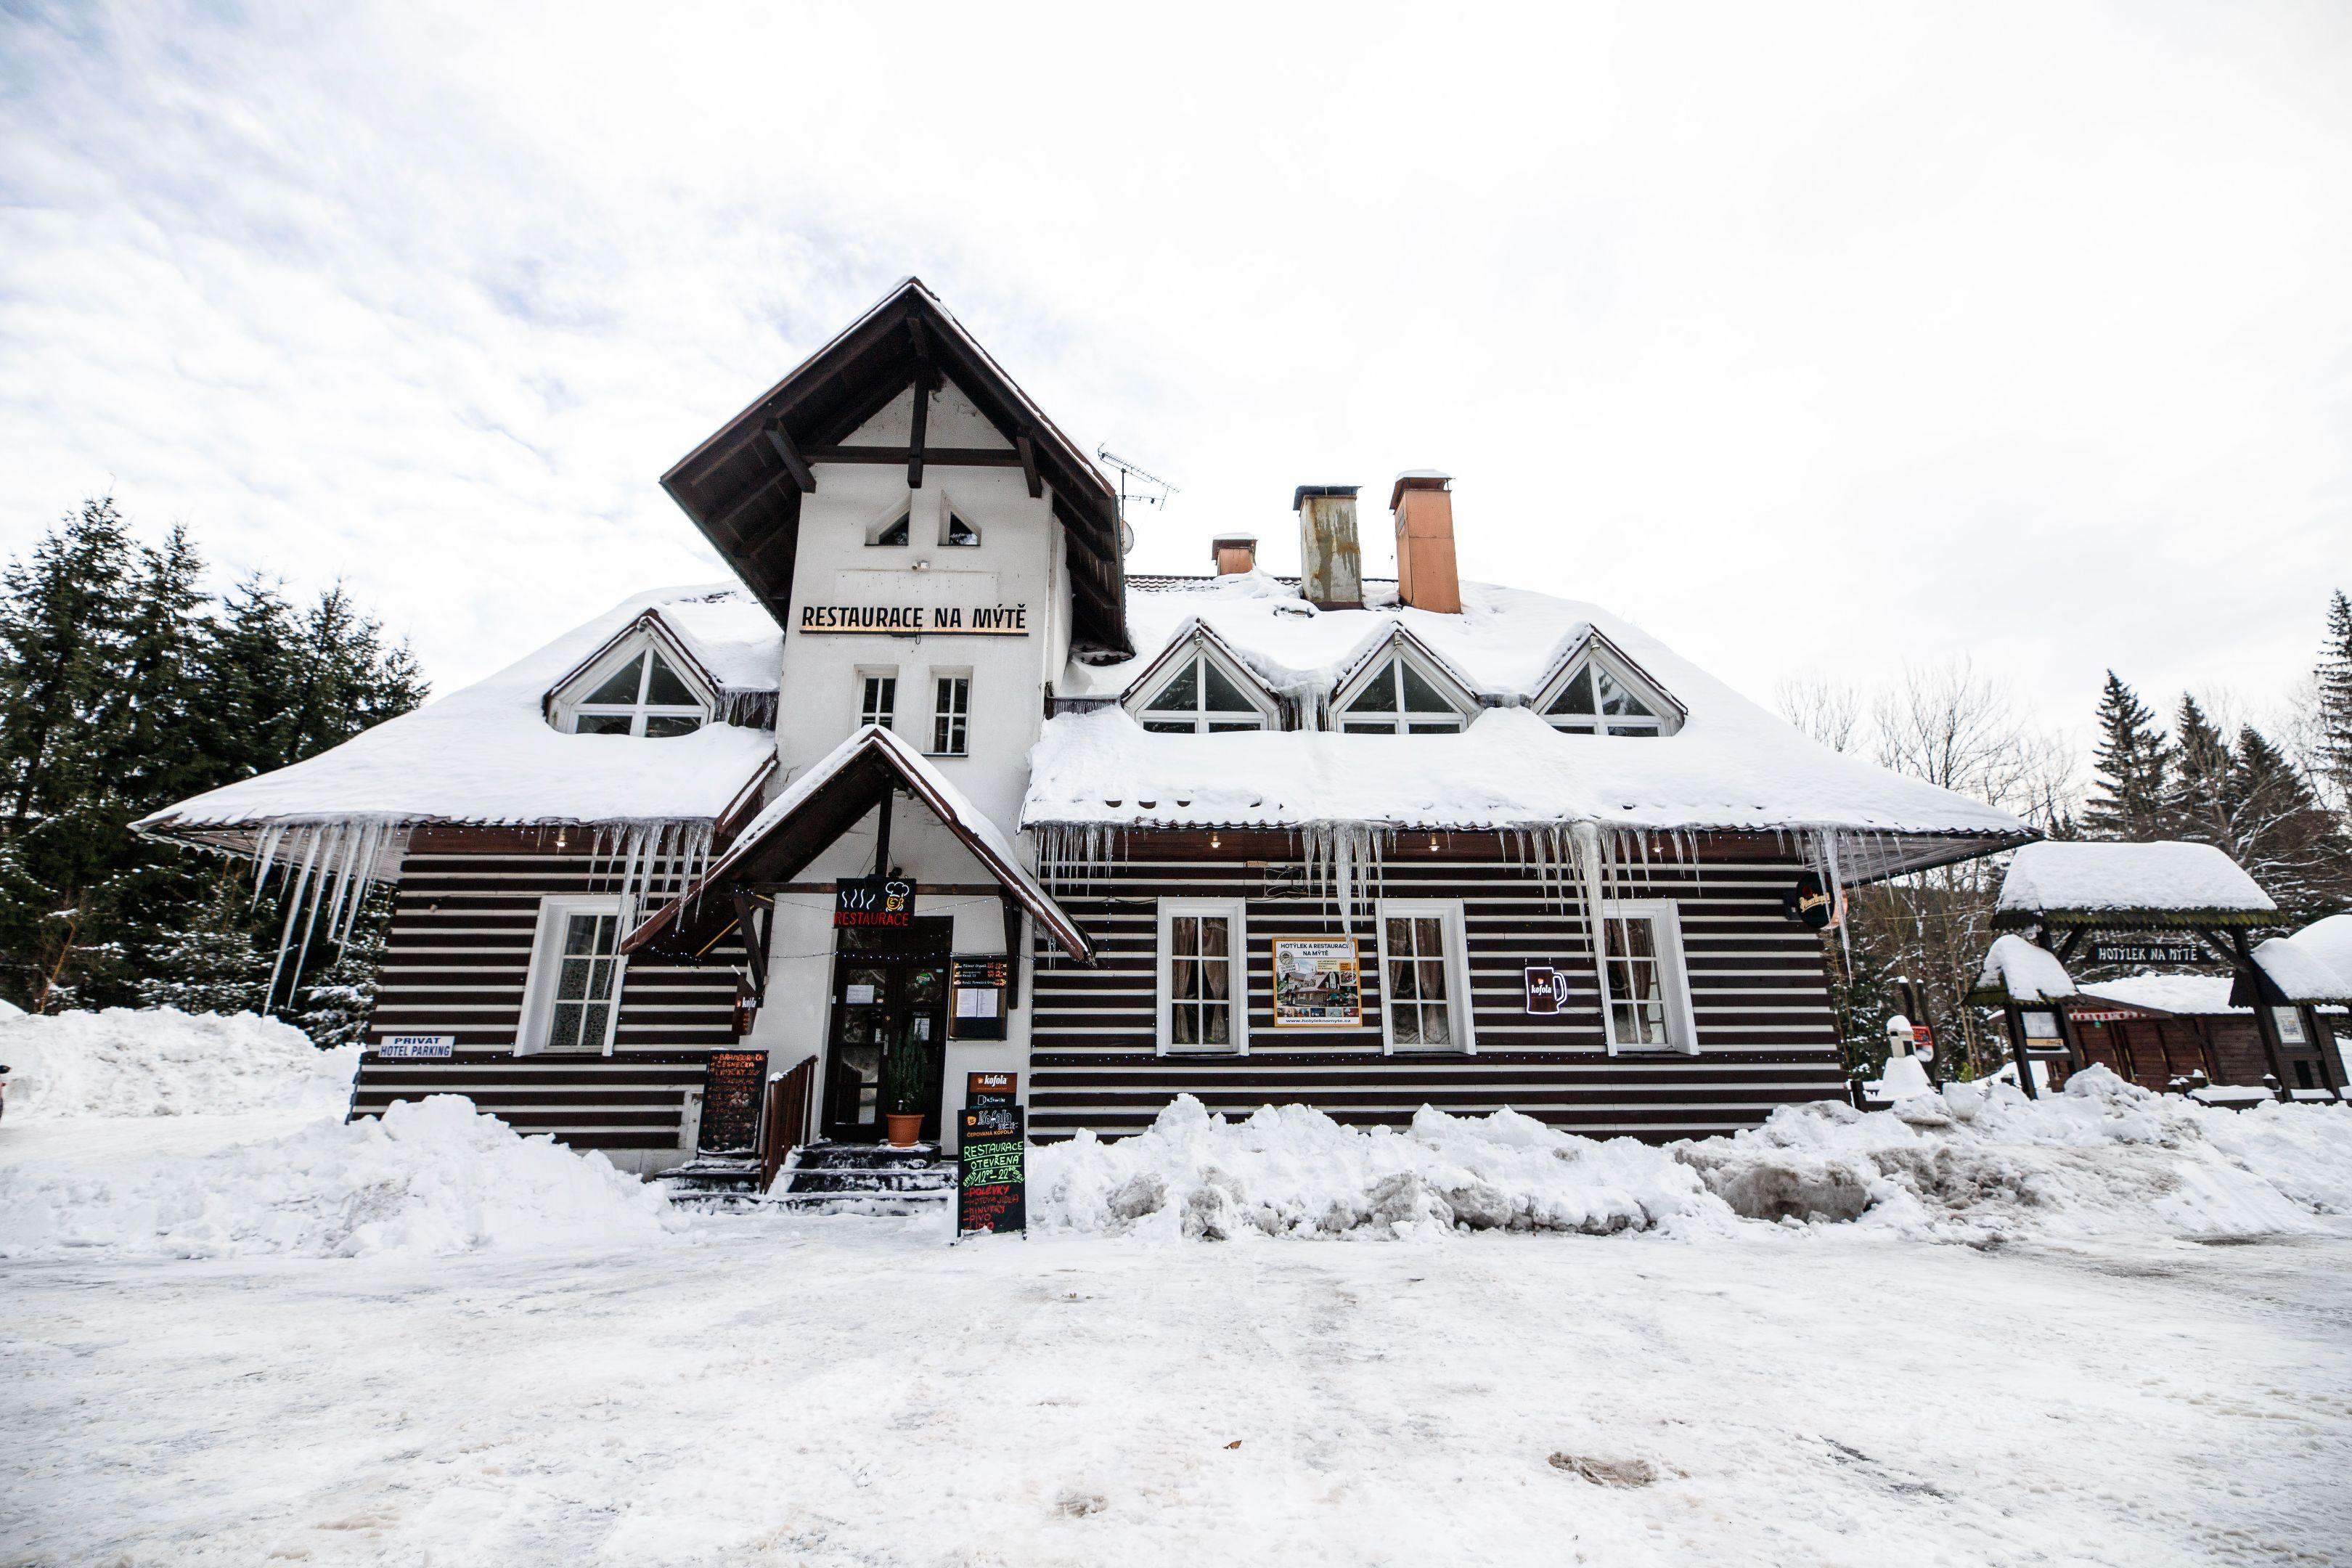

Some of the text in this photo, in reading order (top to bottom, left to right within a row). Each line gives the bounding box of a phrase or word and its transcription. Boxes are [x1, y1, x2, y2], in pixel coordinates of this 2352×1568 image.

[801, 603, 1026, 629] RESTAURACE NA MÝTĚ
[834, 911, 910, 926] RESTAURACE
[2099, 944, 2198, 960] HOTÝLEK NA MÝTĚ
[1531, 984, 1552, 996] kofola
[380, 1045, 450, 1056] HOTEL PARKING
[984, 1074, 1007, 1087] kofola
[964, 1141, 1024, 1159] RESTAURACE
[971, 1153, 1021, 1169] OTEVŘENÁ
[963, 1171, 977, 1187] OFFEN
